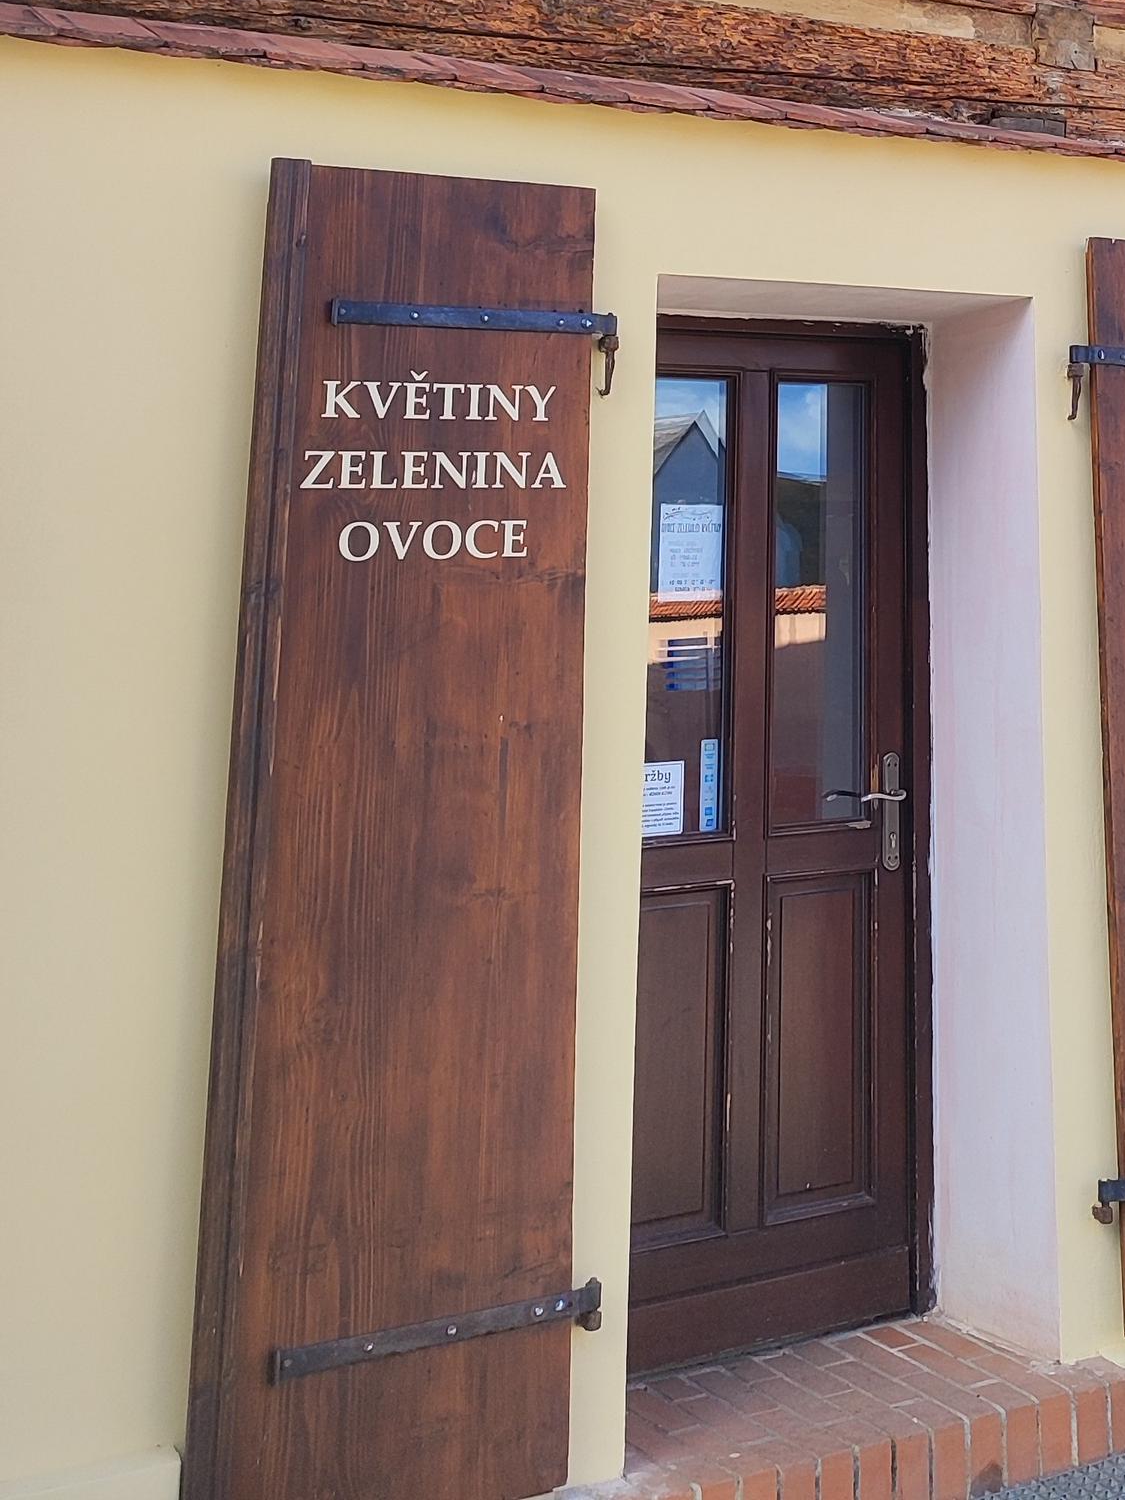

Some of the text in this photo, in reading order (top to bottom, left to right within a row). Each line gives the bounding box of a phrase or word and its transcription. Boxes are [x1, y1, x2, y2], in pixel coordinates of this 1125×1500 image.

[320, 369, 557, 422] KVĚTINY
[299, 450, 568, 490] ZELENINA
[338, 519, 529, 562] OVOCE
[644, 769, 671, 784] ržby
